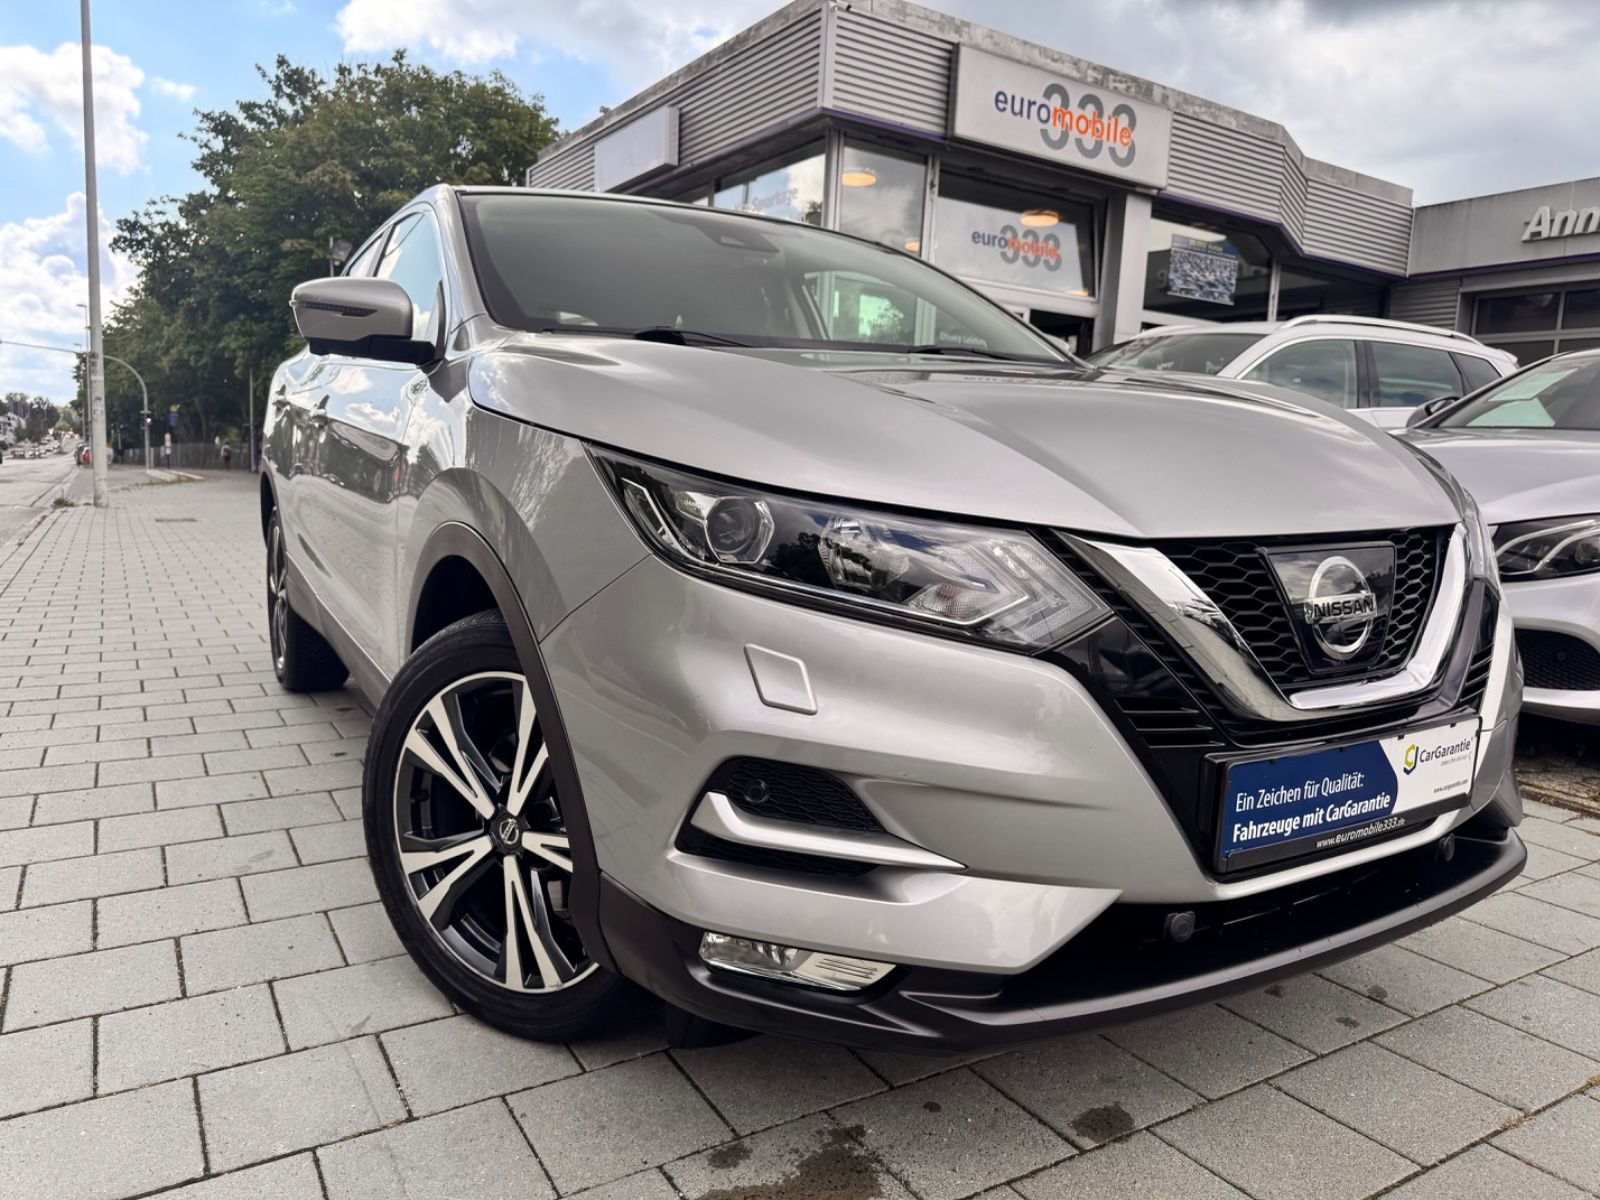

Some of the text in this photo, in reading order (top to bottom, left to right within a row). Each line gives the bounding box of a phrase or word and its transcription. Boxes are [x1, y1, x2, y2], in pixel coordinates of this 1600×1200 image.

[994, 90, 1133, 148] euromobile
[1040, 83, 1137, 168] 333
[971, 230, 1060, 260] euromobile
[999, 225, 1063, 272] 333
[1313, 599, 1374, 618] NISSAN
[1419, 739, 1471, 763] CarGarantie
[1235, 772, 1365, 813] Ein Zeichen für Qualität:
[1232, 792, 1391, 843] Fahrzeuge mit CarGarantie
